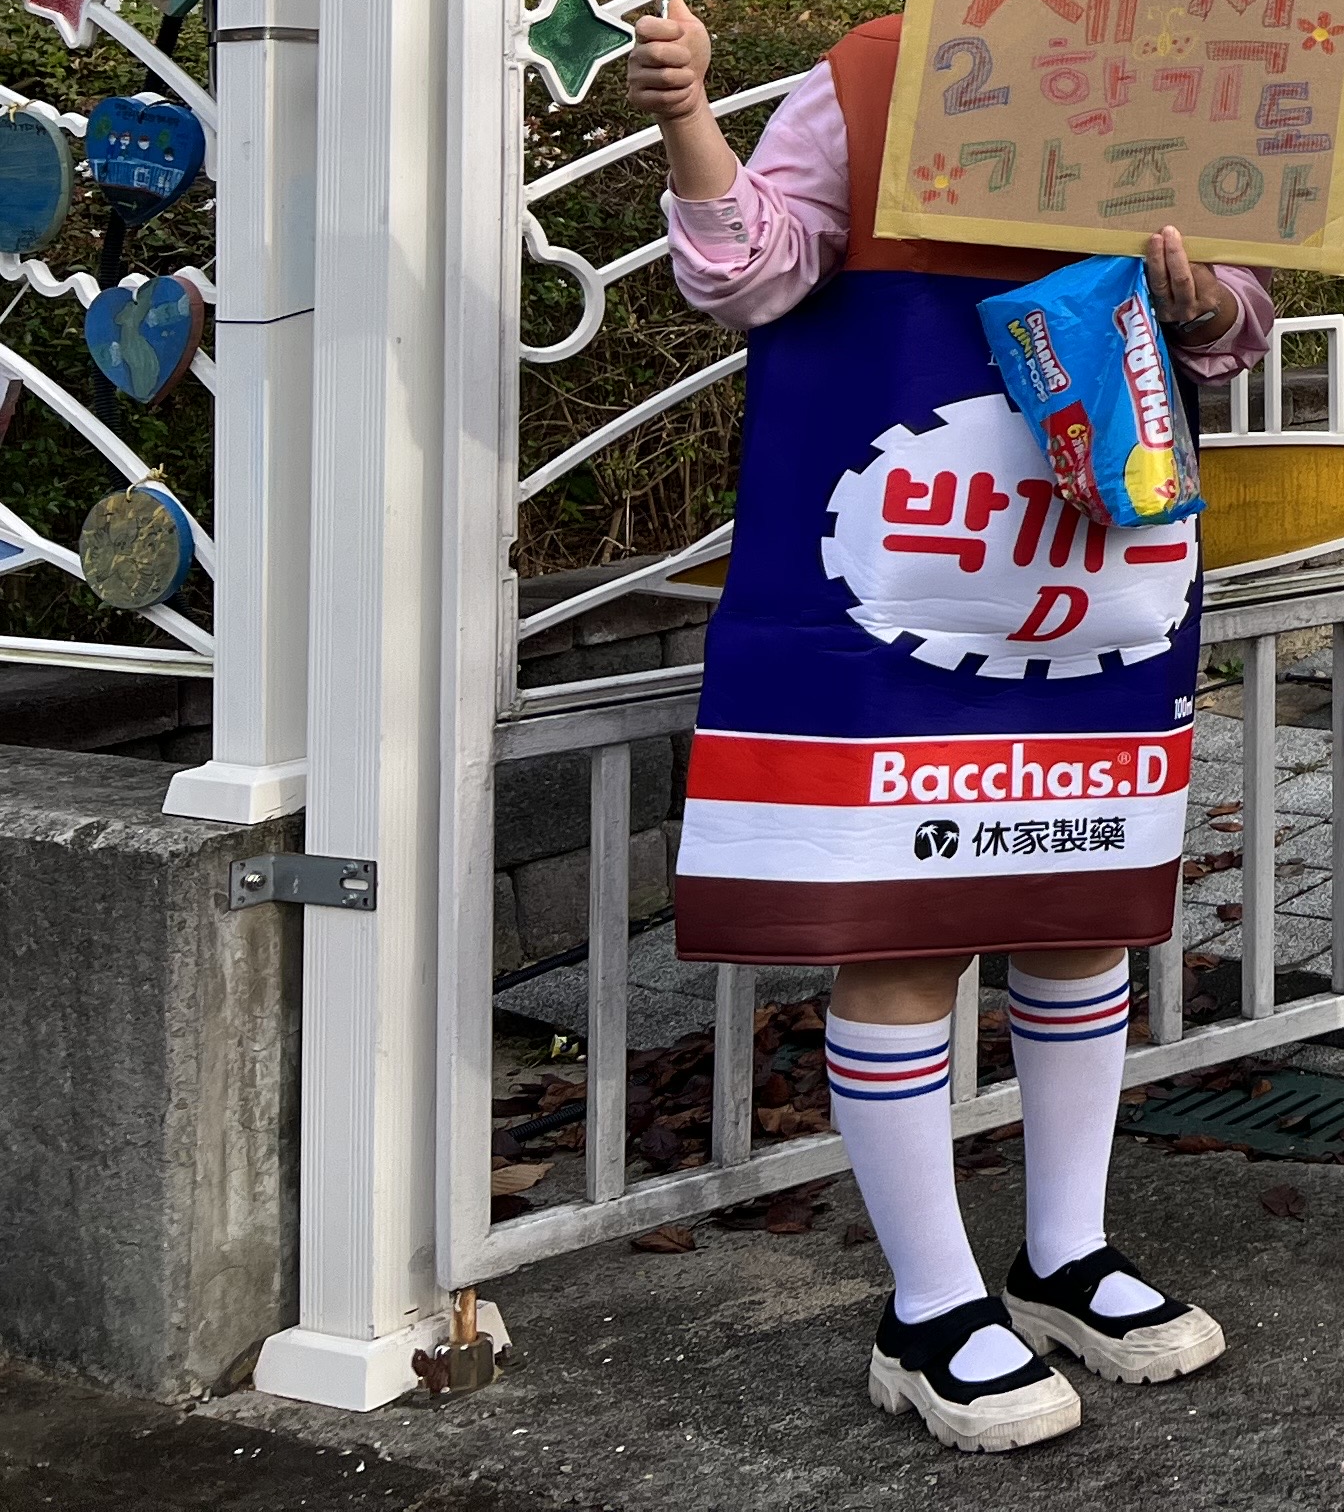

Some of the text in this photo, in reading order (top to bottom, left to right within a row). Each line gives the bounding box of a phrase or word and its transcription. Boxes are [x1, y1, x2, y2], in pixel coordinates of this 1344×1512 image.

[959, 135, 1321, 239] 가즈아
[1008, 320, 1033, 358] MINI
[1026, 358, 1049, 402] POPS
[1026, 312, 1067, 390] CHARMS
[1006, 585, 1089, 642] D
[972, 816, 1126, 857] 休家製藥
